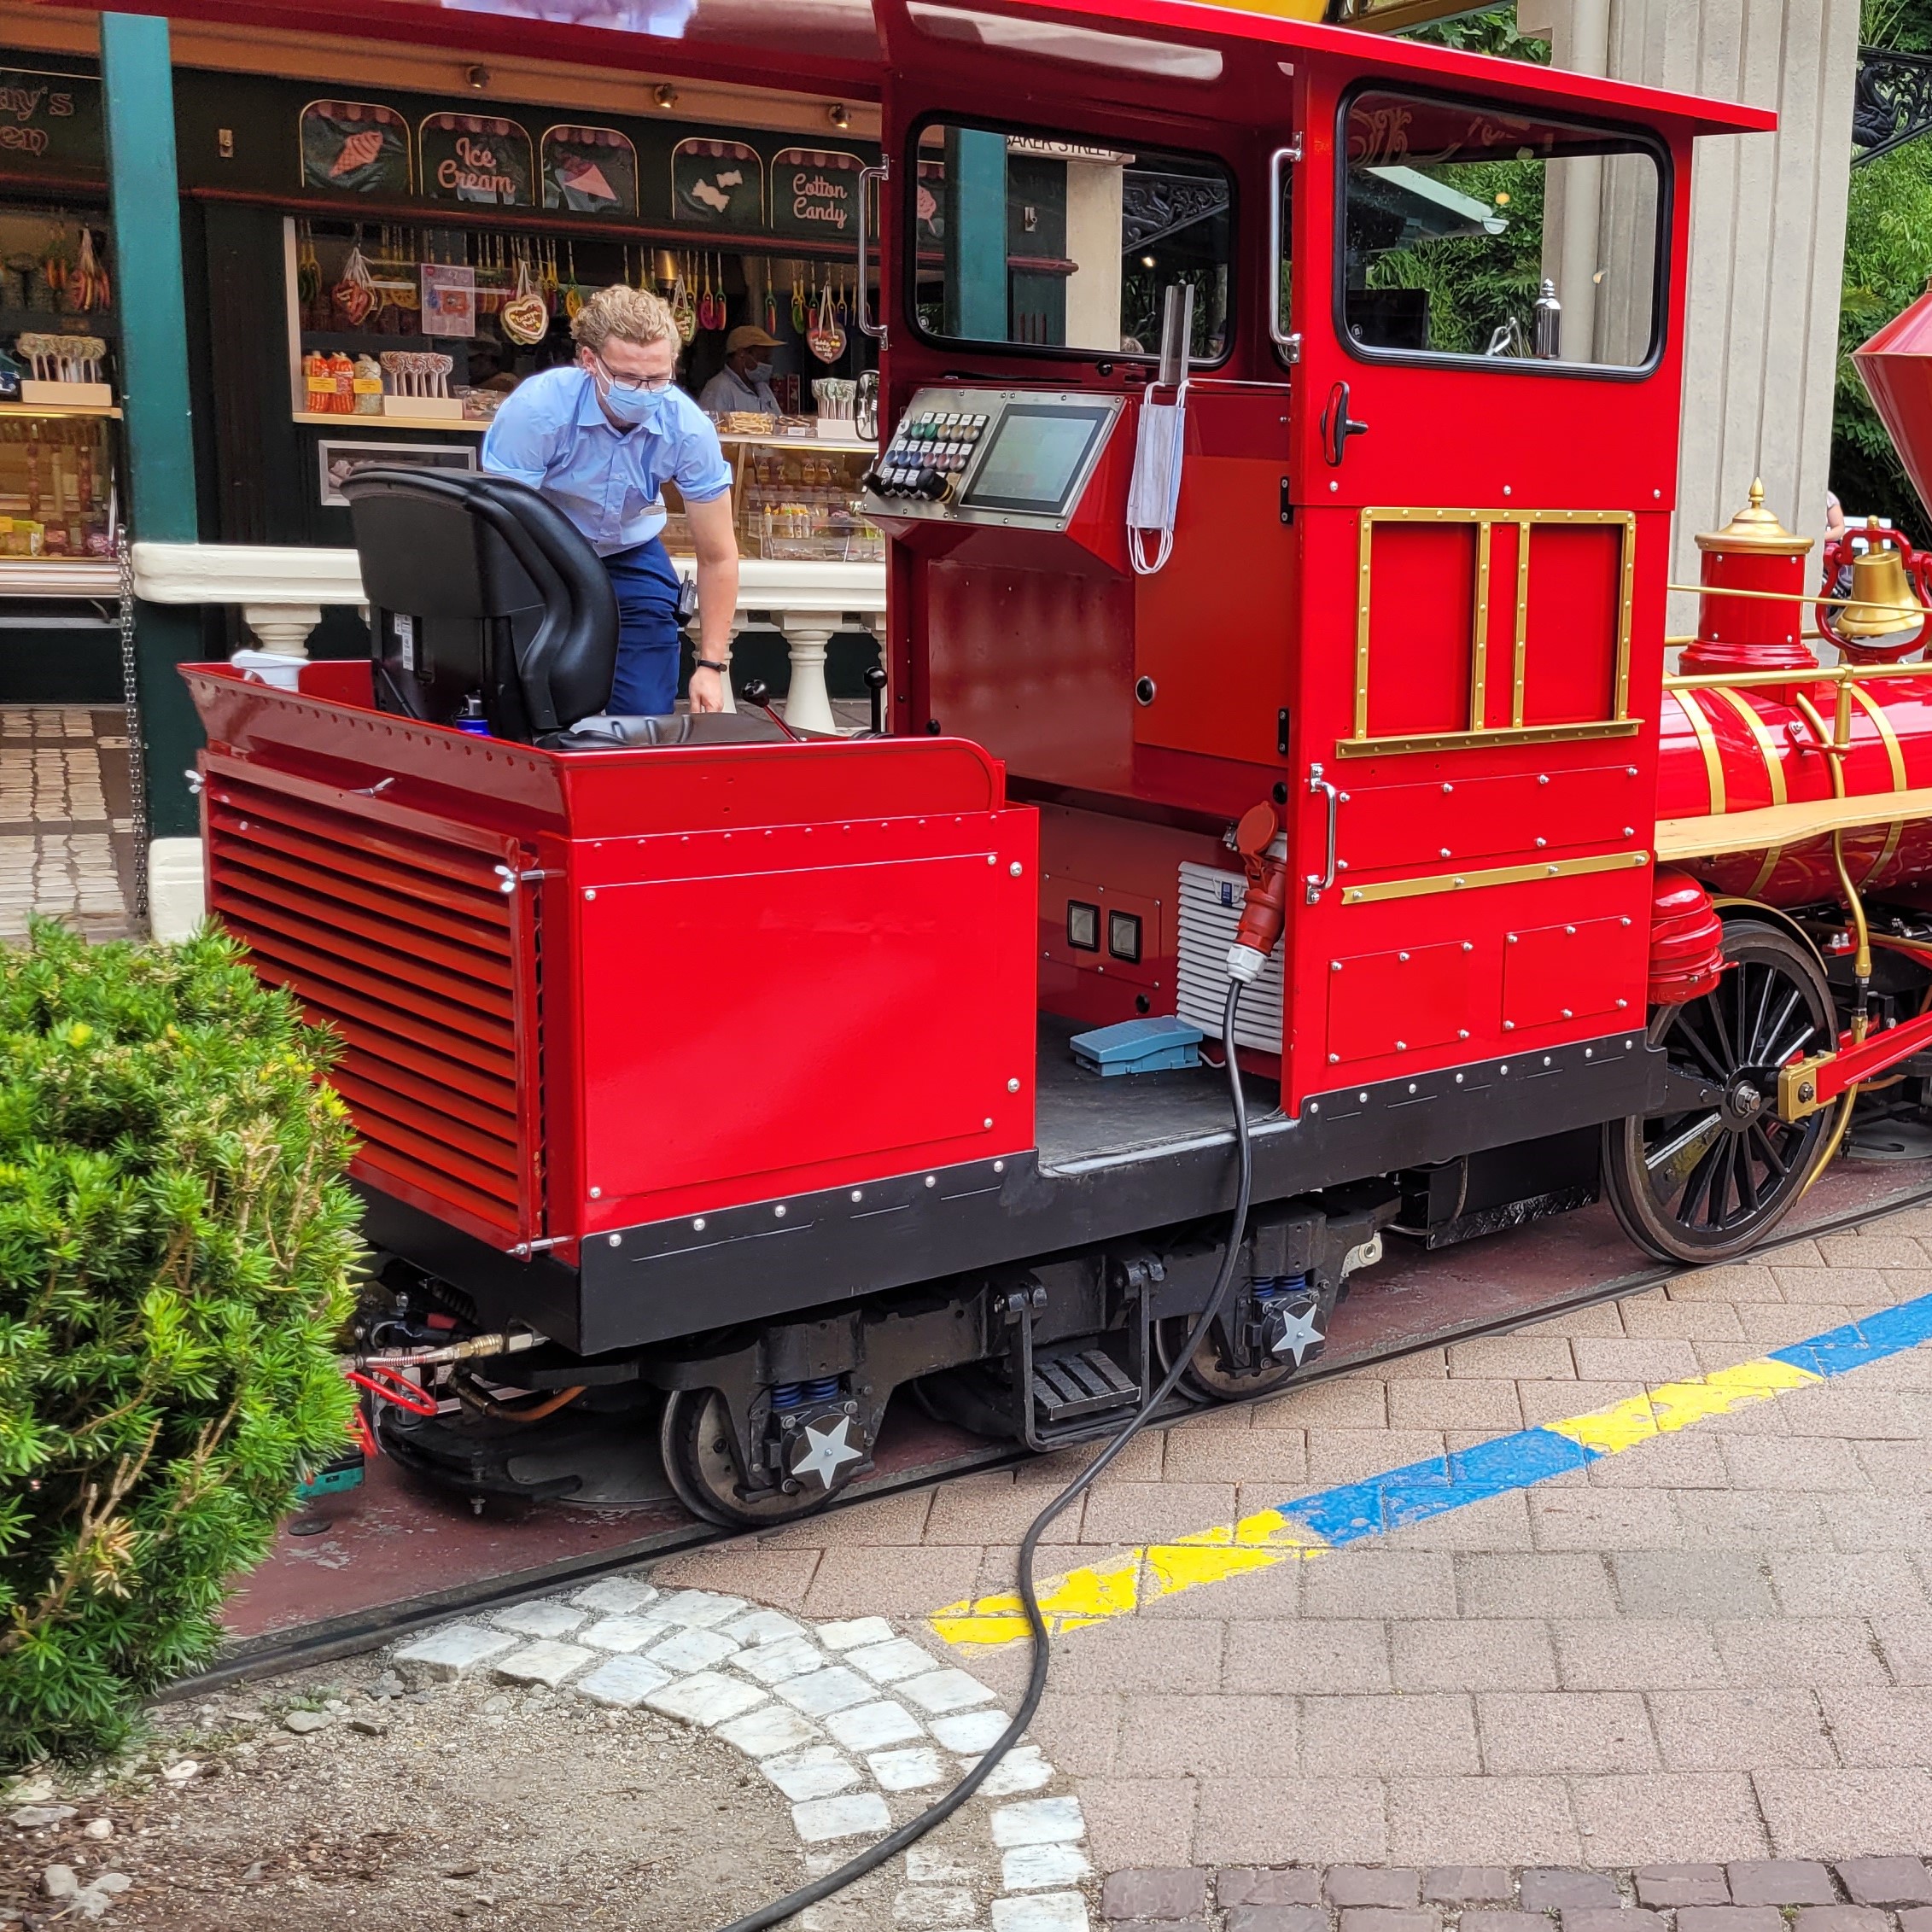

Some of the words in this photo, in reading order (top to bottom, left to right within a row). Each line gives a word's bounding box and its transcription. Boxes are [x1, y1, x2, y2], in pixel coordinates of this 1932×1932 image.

[456, 137, 496, 167] Ice
[437, 160, 516, 194] Cream
[792, 173, 848, 199] Cotton
[793, 196, 848, 229] Candy
